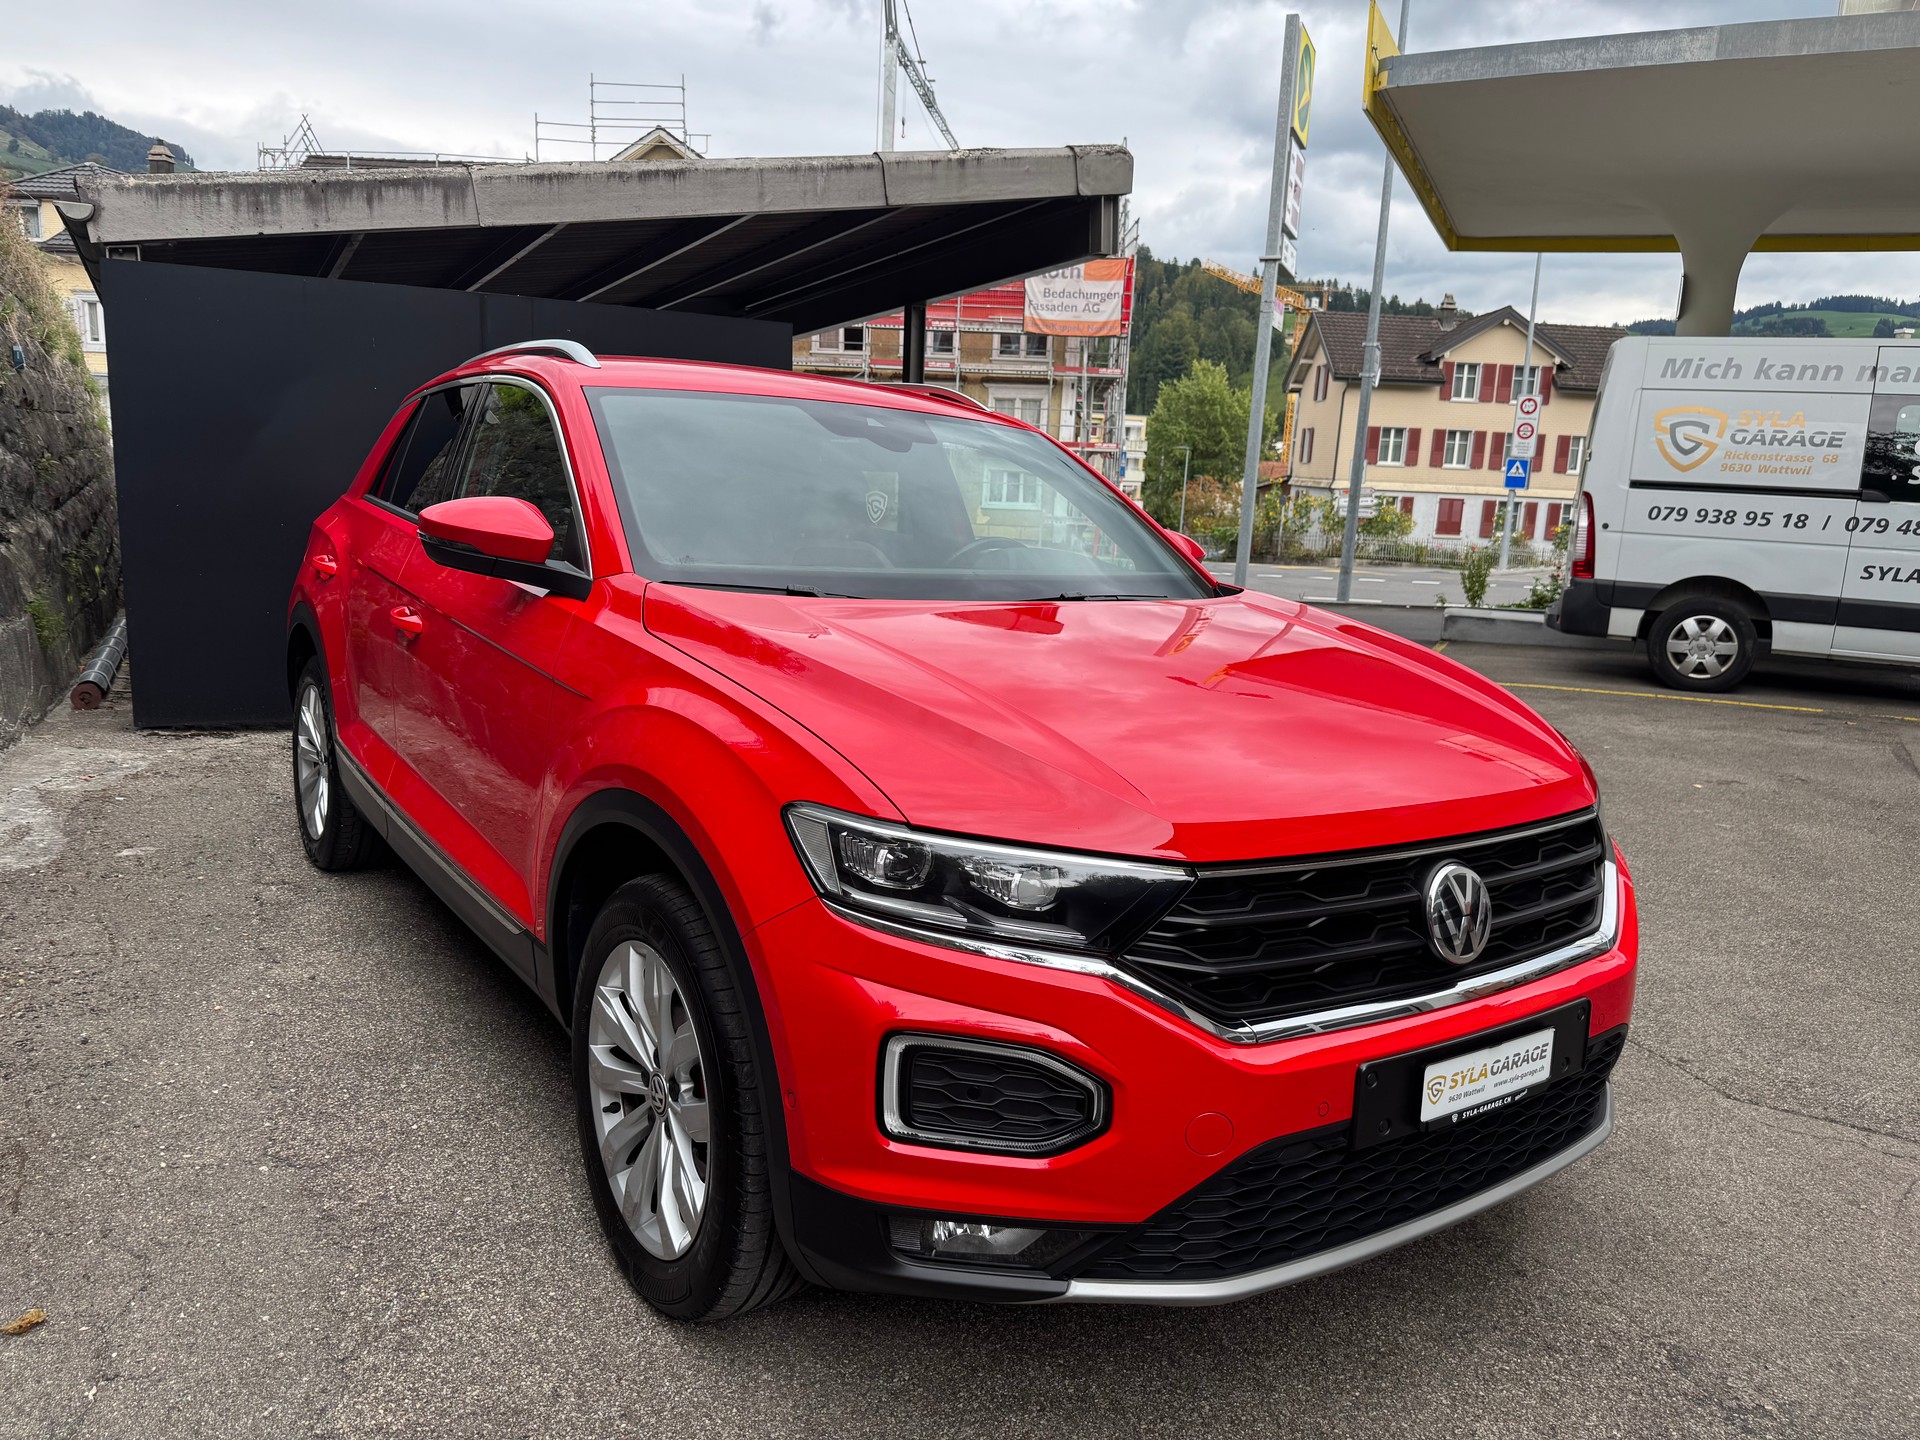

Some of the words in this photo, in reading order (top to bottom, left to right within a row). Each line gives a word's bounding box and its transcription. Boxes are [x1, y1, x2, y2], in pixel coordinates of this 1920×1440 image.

[1042, 267, 1080, 279] oth
[1043, 287, 1120, 303] Bedachungen
[1082, 303, 1100, 313] AG
[1660, 357, 1743, 380] Mich
[1753, 357, 1844, 382] kann
[1736, 410, 1806, 429] SYLA
[1729, 429, 1847, 449] GARAGE
[1723, 451, 1815, 463] Rickenstrasse
[1822, 453, 1839, 465] 68
[1719, 462, 1752, 474] 9630
[1756, 463, 1812, 476] Wattwil
[1647, 505, 1688, 522] 079
[1694, 508, 1738, 525] 938
[1743, 511, 1773, 528] 95
[1782, 513, 1810, 530] 18
[1821, 515, 1832, 531] /
[1844, 516, 1890, 534] 079
[1860, 565, 1920, 584] SYLA
[1448, 1063, 1488, 1090] SYLA
[1490, 1042, 1550, 1076] GARAGE
[1448, 1092, 1462, 1104] 9630
[1463, 1085, 1486, 1098] Wattwil
[1493, 1065, 1545, 1089] www.syla-garage.ch
[1462, 1096, 1512, 1119] SYLA-GARAGE.CH
